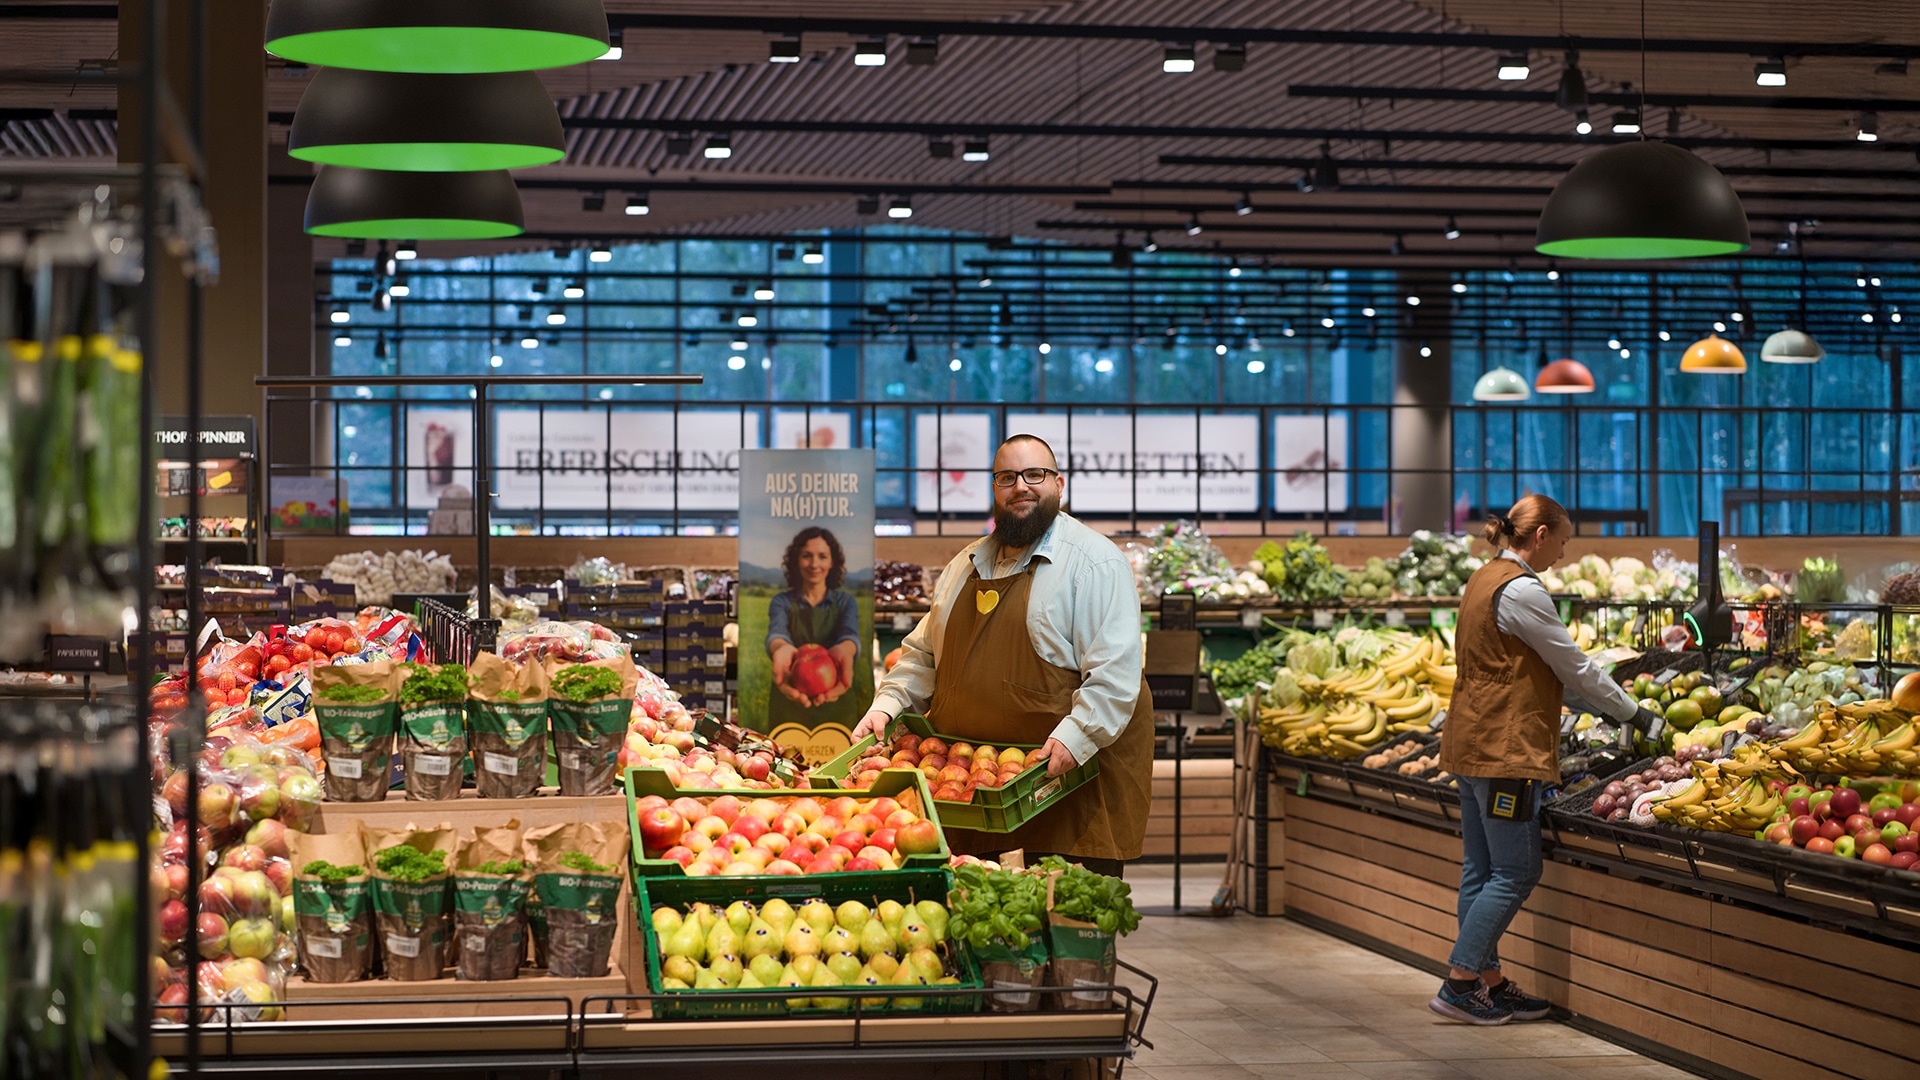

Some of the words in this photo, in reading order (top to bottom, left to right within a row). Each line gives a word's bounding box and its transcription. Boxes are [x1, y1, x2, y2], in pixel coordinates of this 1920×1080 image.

[1055, 452, 1246, 479] ERVIETTEN
[765, 472, 798, 494] AUS
[801, 472, 859, 494] DEINER
[770, 493, 855, 520] NA(H)TUR.
[805, 745, 835, 756] HERZEN
